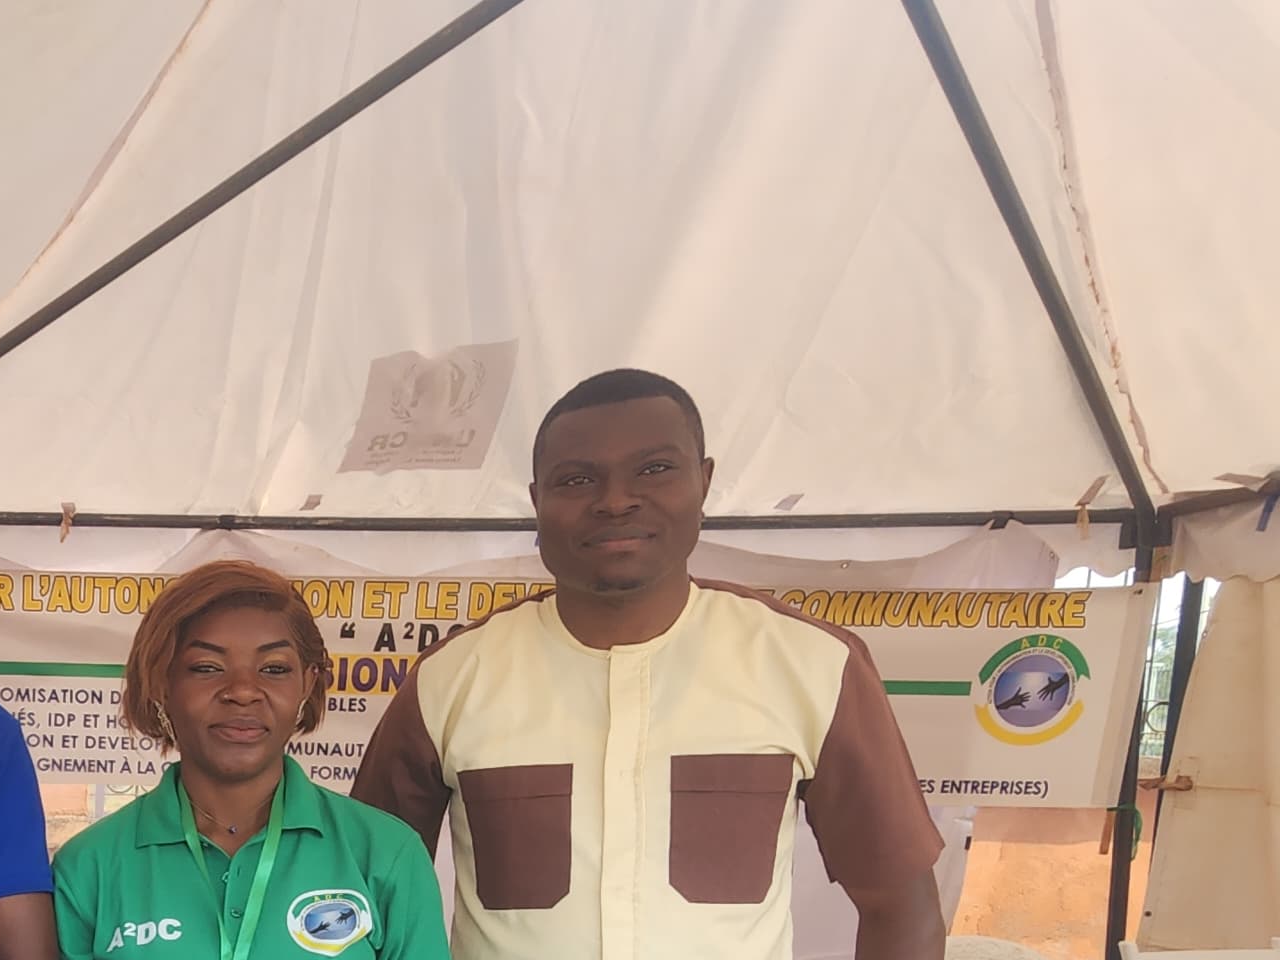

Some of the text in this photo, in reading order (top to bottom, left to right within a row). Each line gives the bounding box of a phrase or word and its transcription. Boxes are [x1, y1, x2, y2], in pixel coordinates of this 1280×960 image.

[22, 574, 179, 614] L'AUTON
[361, 581, 409, 620] ET
[415, 581, 454, 621] LE
[374, 622, 465, 653] A²D
[327, 698, 367, 712] BLES
[13, 709, 41, 729] ÉS,
[48, 713, 76, 727] IDP
[83, 714, 99, 728] ET
[61, 735, 79, 749] ET
[120, 757, 132, 773] À
[137, 761, 156, 775] LA
[940, 779, 1049, 798] ENTREPRISES)
